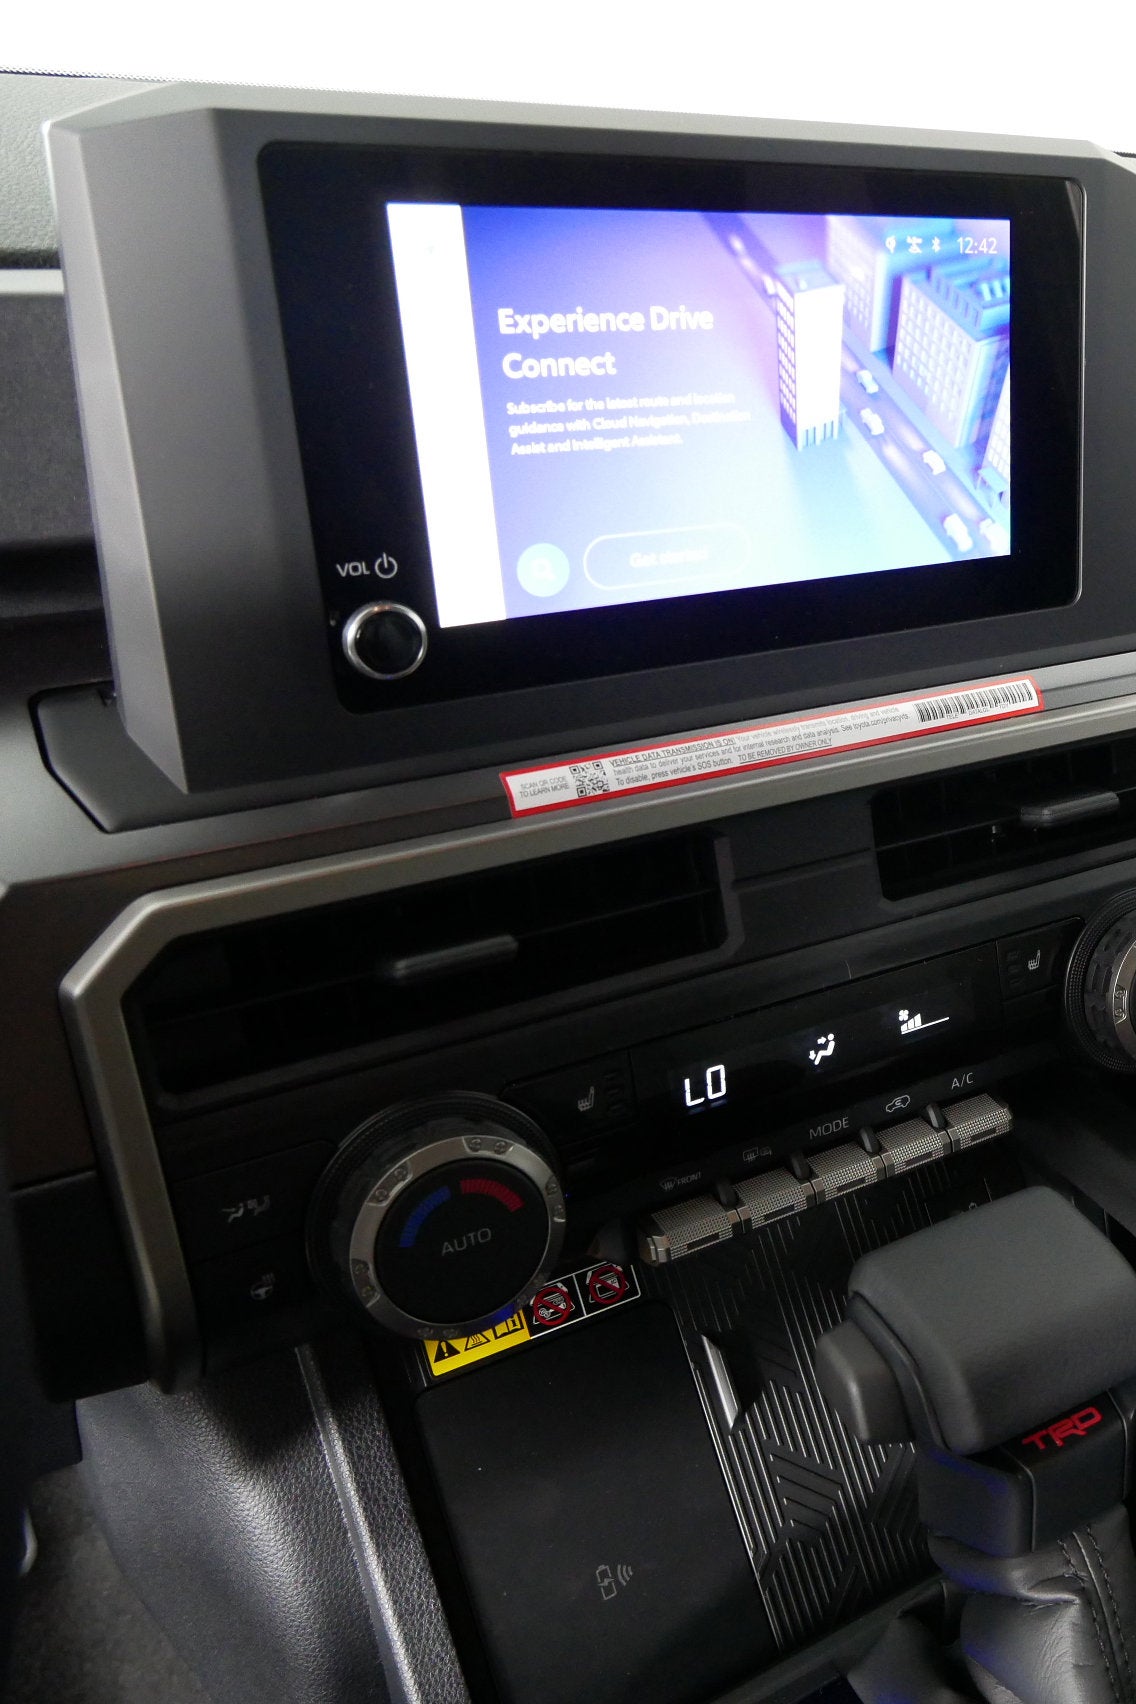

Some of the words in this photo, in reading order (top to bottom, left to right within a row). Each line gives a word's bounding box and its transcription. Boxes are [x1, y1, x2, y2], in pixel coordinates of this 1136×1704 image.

[957, 237, 998, 254] 12:42
[497, 306, 645, 340] Experience
[650, 305, 714, 331] Drive
[502, 352, 617, 379] Connect
[506, 400, 566, 415] Subscribe
[566, 398, 583, 412] for
[584, 397, 605, 411] the
[508, 421, 565, 438] guidance
[565, 418, 591, 432] with
[592, 416, 628, 431] Cloud
[511, 442, 546, 455] Assist
[547, 439, 571, 453] and
[335, 561, 371, 577] VOL
[609, 754, 640, 767] VEHICLE
[641, 751, 661, 761] DATA
[661, 741, 714, 758] TRANSMISSION
[714, 740, 722, 748] IS
[634, 763, 649, 772] data
[658, 758, 678, 768] deliver
[680, 755, 693, 765] your
[695, 749, 720, 760] services
[743, 742, 765, 751] internal
[765, 736, 790, 747] research
[792, 734, 802, 742] and
[803, 730, 815, 740] data
[841, 723, 853, 732] See
[616, 777, 625, 786] To
[625, 773, 650, 784] disable,
[651, 770, 669, 780] press
[670, 764, 697, 776] vehicle's
[697, 760, 712, 770] SOS
[713, 758, 733, 769] button.
[738, 754, 747, 762] TO
[757, 748, 786, 758] REMOVED
[795, 741, 818, 751] OWNER
[818, 737, 832, 747] ONLY
[519, 790, 529, 798] TO
[529, 786, 551, 797] LEARN
[551, 782, 570, 792] MORE
[520, 781, 538, 790] SCAN
[683, 1063, 728, 1108] LO
[951, 1072, 975, 1090] A/C
[808, 1116, 850, 1140] MODE
[677, 1171, 702, 1186] FRONT
[441, 1227, 492, 1257] AUTO
[1021, 1406, 1103, 1450] TRD
